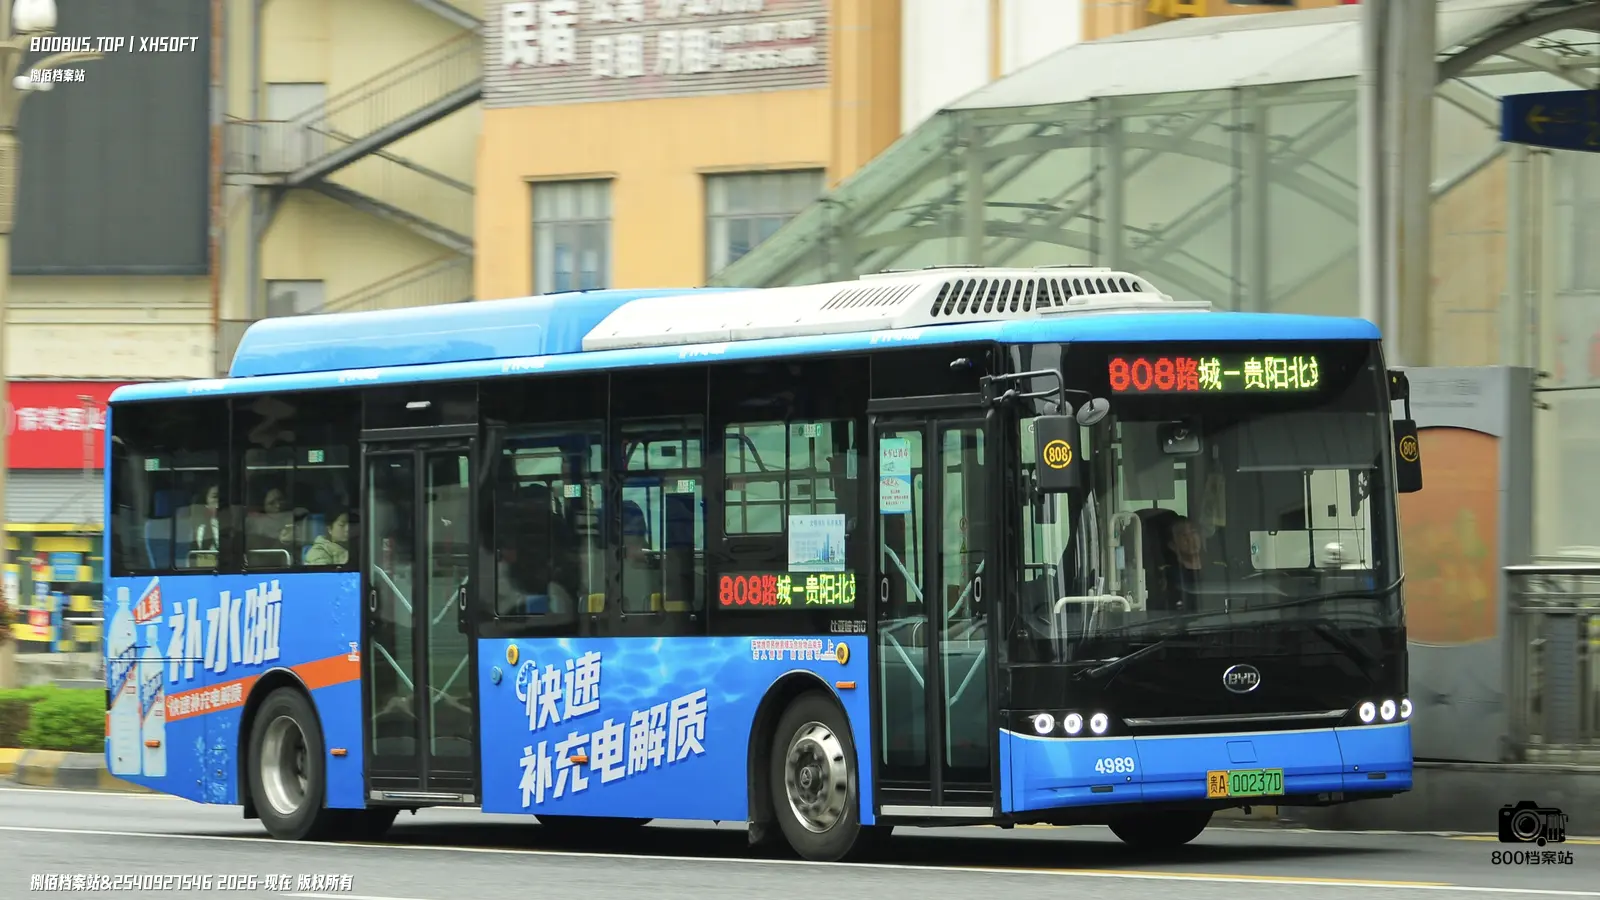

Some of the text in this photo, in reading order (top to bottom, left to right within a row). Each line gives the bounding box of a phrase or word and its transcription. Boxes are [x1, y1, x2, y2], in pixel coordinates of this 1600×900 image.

[502, 2, 579, 67] 民宿
[1049, 447, 1068, 462] 808
[166, 579, 282, 683] 补水啦
[525, 650, 600, 731] 快速
[1228, 672, 1257, 685] BYD
[168, 683, 243, 717] 快速补充电解质
[518, 688, 707, 808] 补充电解质
[1095, 757, 1135, 774] 4989
[1232, 772, 1282, 793] 00237D
